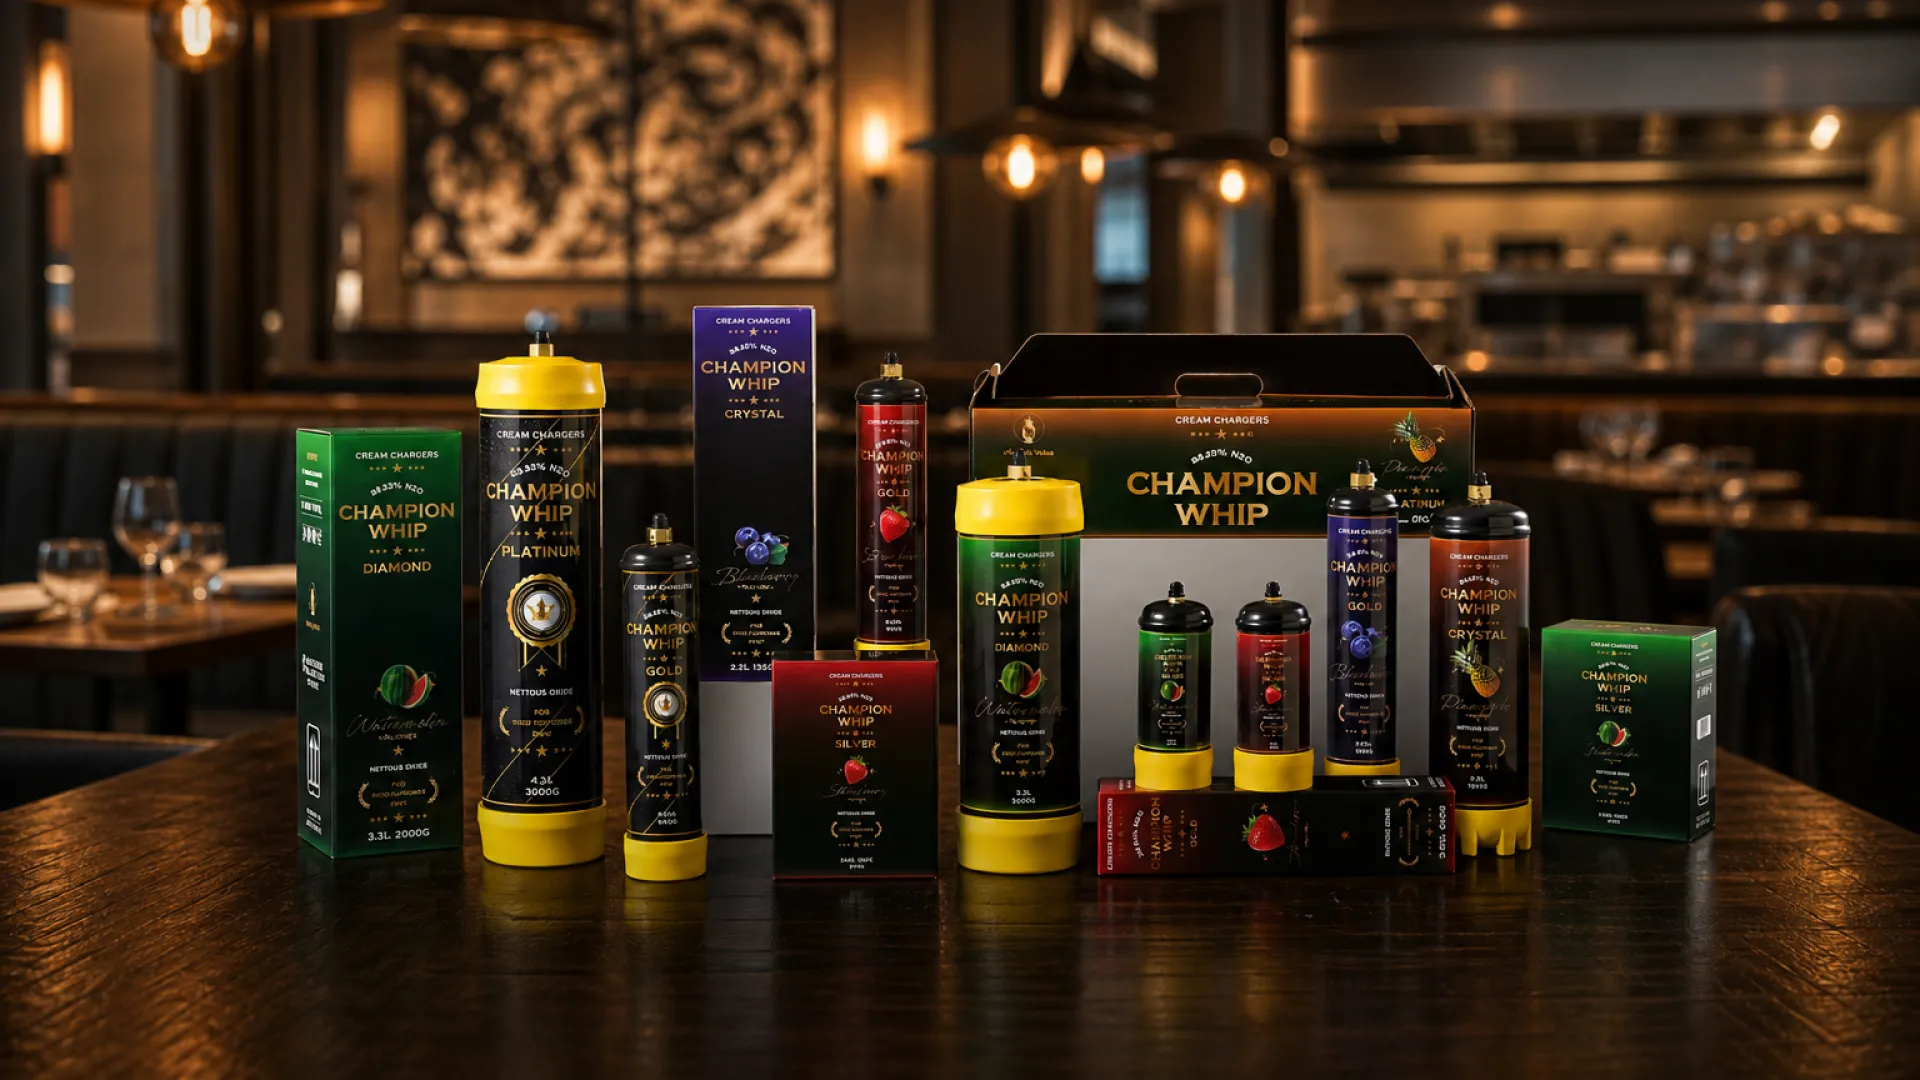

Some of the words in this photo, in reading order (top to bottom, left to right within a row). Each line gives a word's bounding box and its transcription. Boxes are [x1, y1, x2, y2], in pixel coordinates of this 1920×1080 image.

[700, 360, 806, 374] CHAMPION
[727, 377, 781, 391] WHIP
[724, 409, 785, 420] CRYSTAL
[1175, 415, 1211, 425] CREAM
[1214, 415, 1270, 425] CHARGERS
[496, 430, 529, 439] CREAM
[532, 430, 585, 439] CHARGERS
[355, 452, 389, 460] CREAM
[861, 450, 924, 461] CHAMPION
[875, 463, 912, 475] WHIP
[1126, 470, 1318, 497] CHAMPION
[486, 482, 596, 500] CHAMPION
[877, 489, 911, 498] GOLD
[338, 502, 455, 520] CHAMPION
[509, 504, 573, 522] WHIP
[1173, 502, 1270, 526] WHIP
[368, 523, 428, 539] WHIP
[501, 545, 581, 558] PLATINUM
[363, 561, 432, 575] DIAMOND
[1330, 560, 1396, 574] CHAMPION
[1345, 575, 1386, 588] WHIP
[975, 591, 1068, 607] CHAMPION
[1440, 587, 1518, 601] CHAMPION
[1347, 601, 1382, 612] GOLD
[1458, 602, 1501, 615] WHIP
[997, 609, 1048, 625] WHIP
[626, 622, 697, 637] CHAMPION
[1448, 628, 1508, 641] CRYSTAL
[642, 636, 685, 651] WHIP
[994, 642, 1050, 652] DIAMOND
[645, 665, 683, 677] GOLD
[730, 663, 750, 671] 2.2L
[1581, 670, 1648, 684] CHAMPION
[1597, 683, 1631, 694] WHIP
[819, 705, 892, 715] CHAMPION
[1595, 703, 1633, 714] SILVER
[837, 716, 875, 727] WHIP
[835, 739, 876, 749] SILVER
[525, 787, 560, 797] 3000G
[367, 832, 391, 842] 3.3L
[394, 828, 430, 840] 2000G
